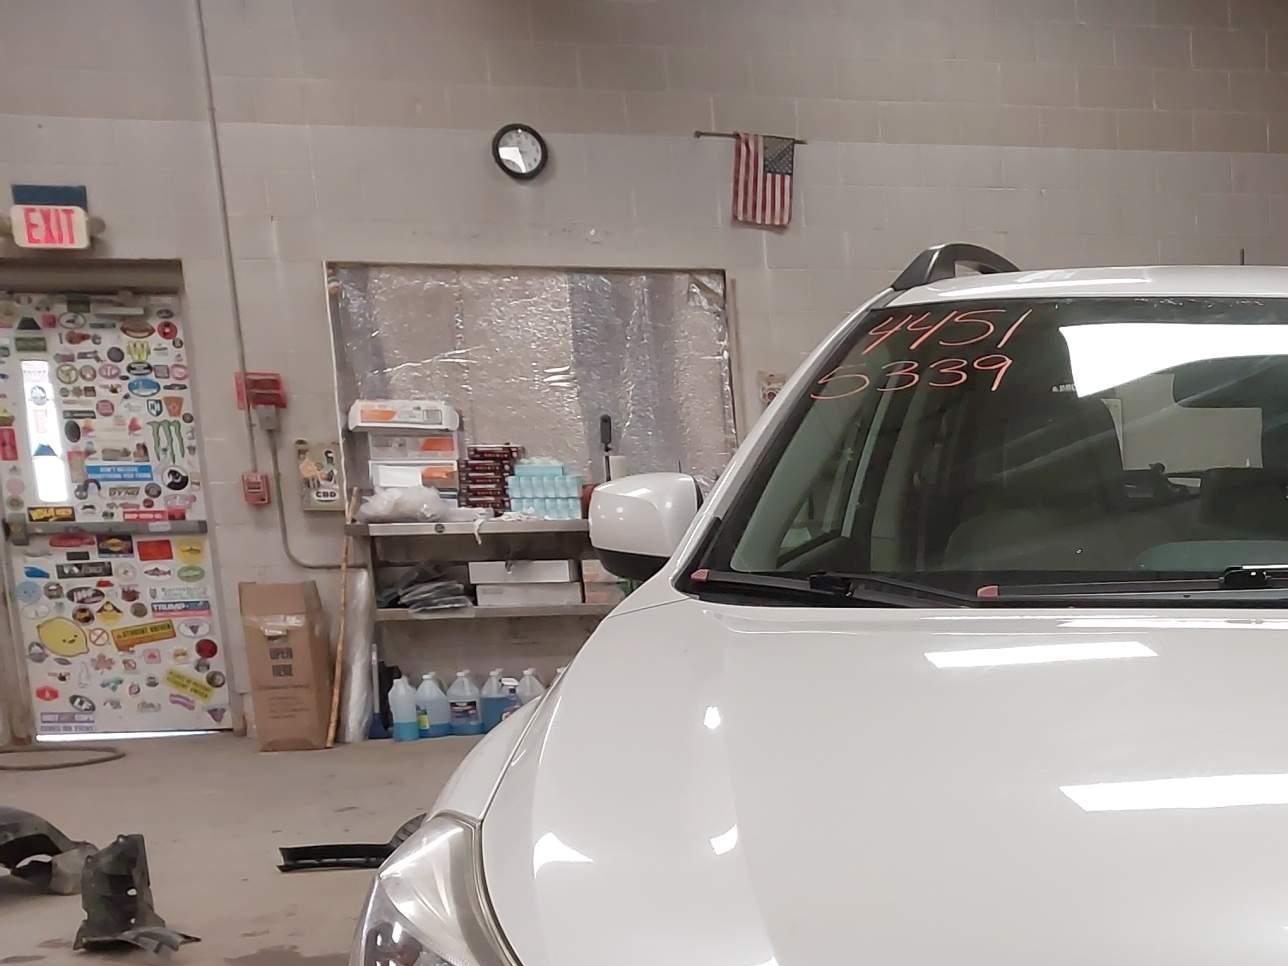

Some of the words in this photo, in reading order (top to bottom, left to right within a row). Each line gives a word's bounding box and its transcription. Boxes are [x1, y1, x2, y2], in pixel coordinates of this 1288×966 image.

[23, 207, 76, 245] EXIT
[863, 308, 1033, 355] 4451
[810, 354, 1013, 400] 5339
